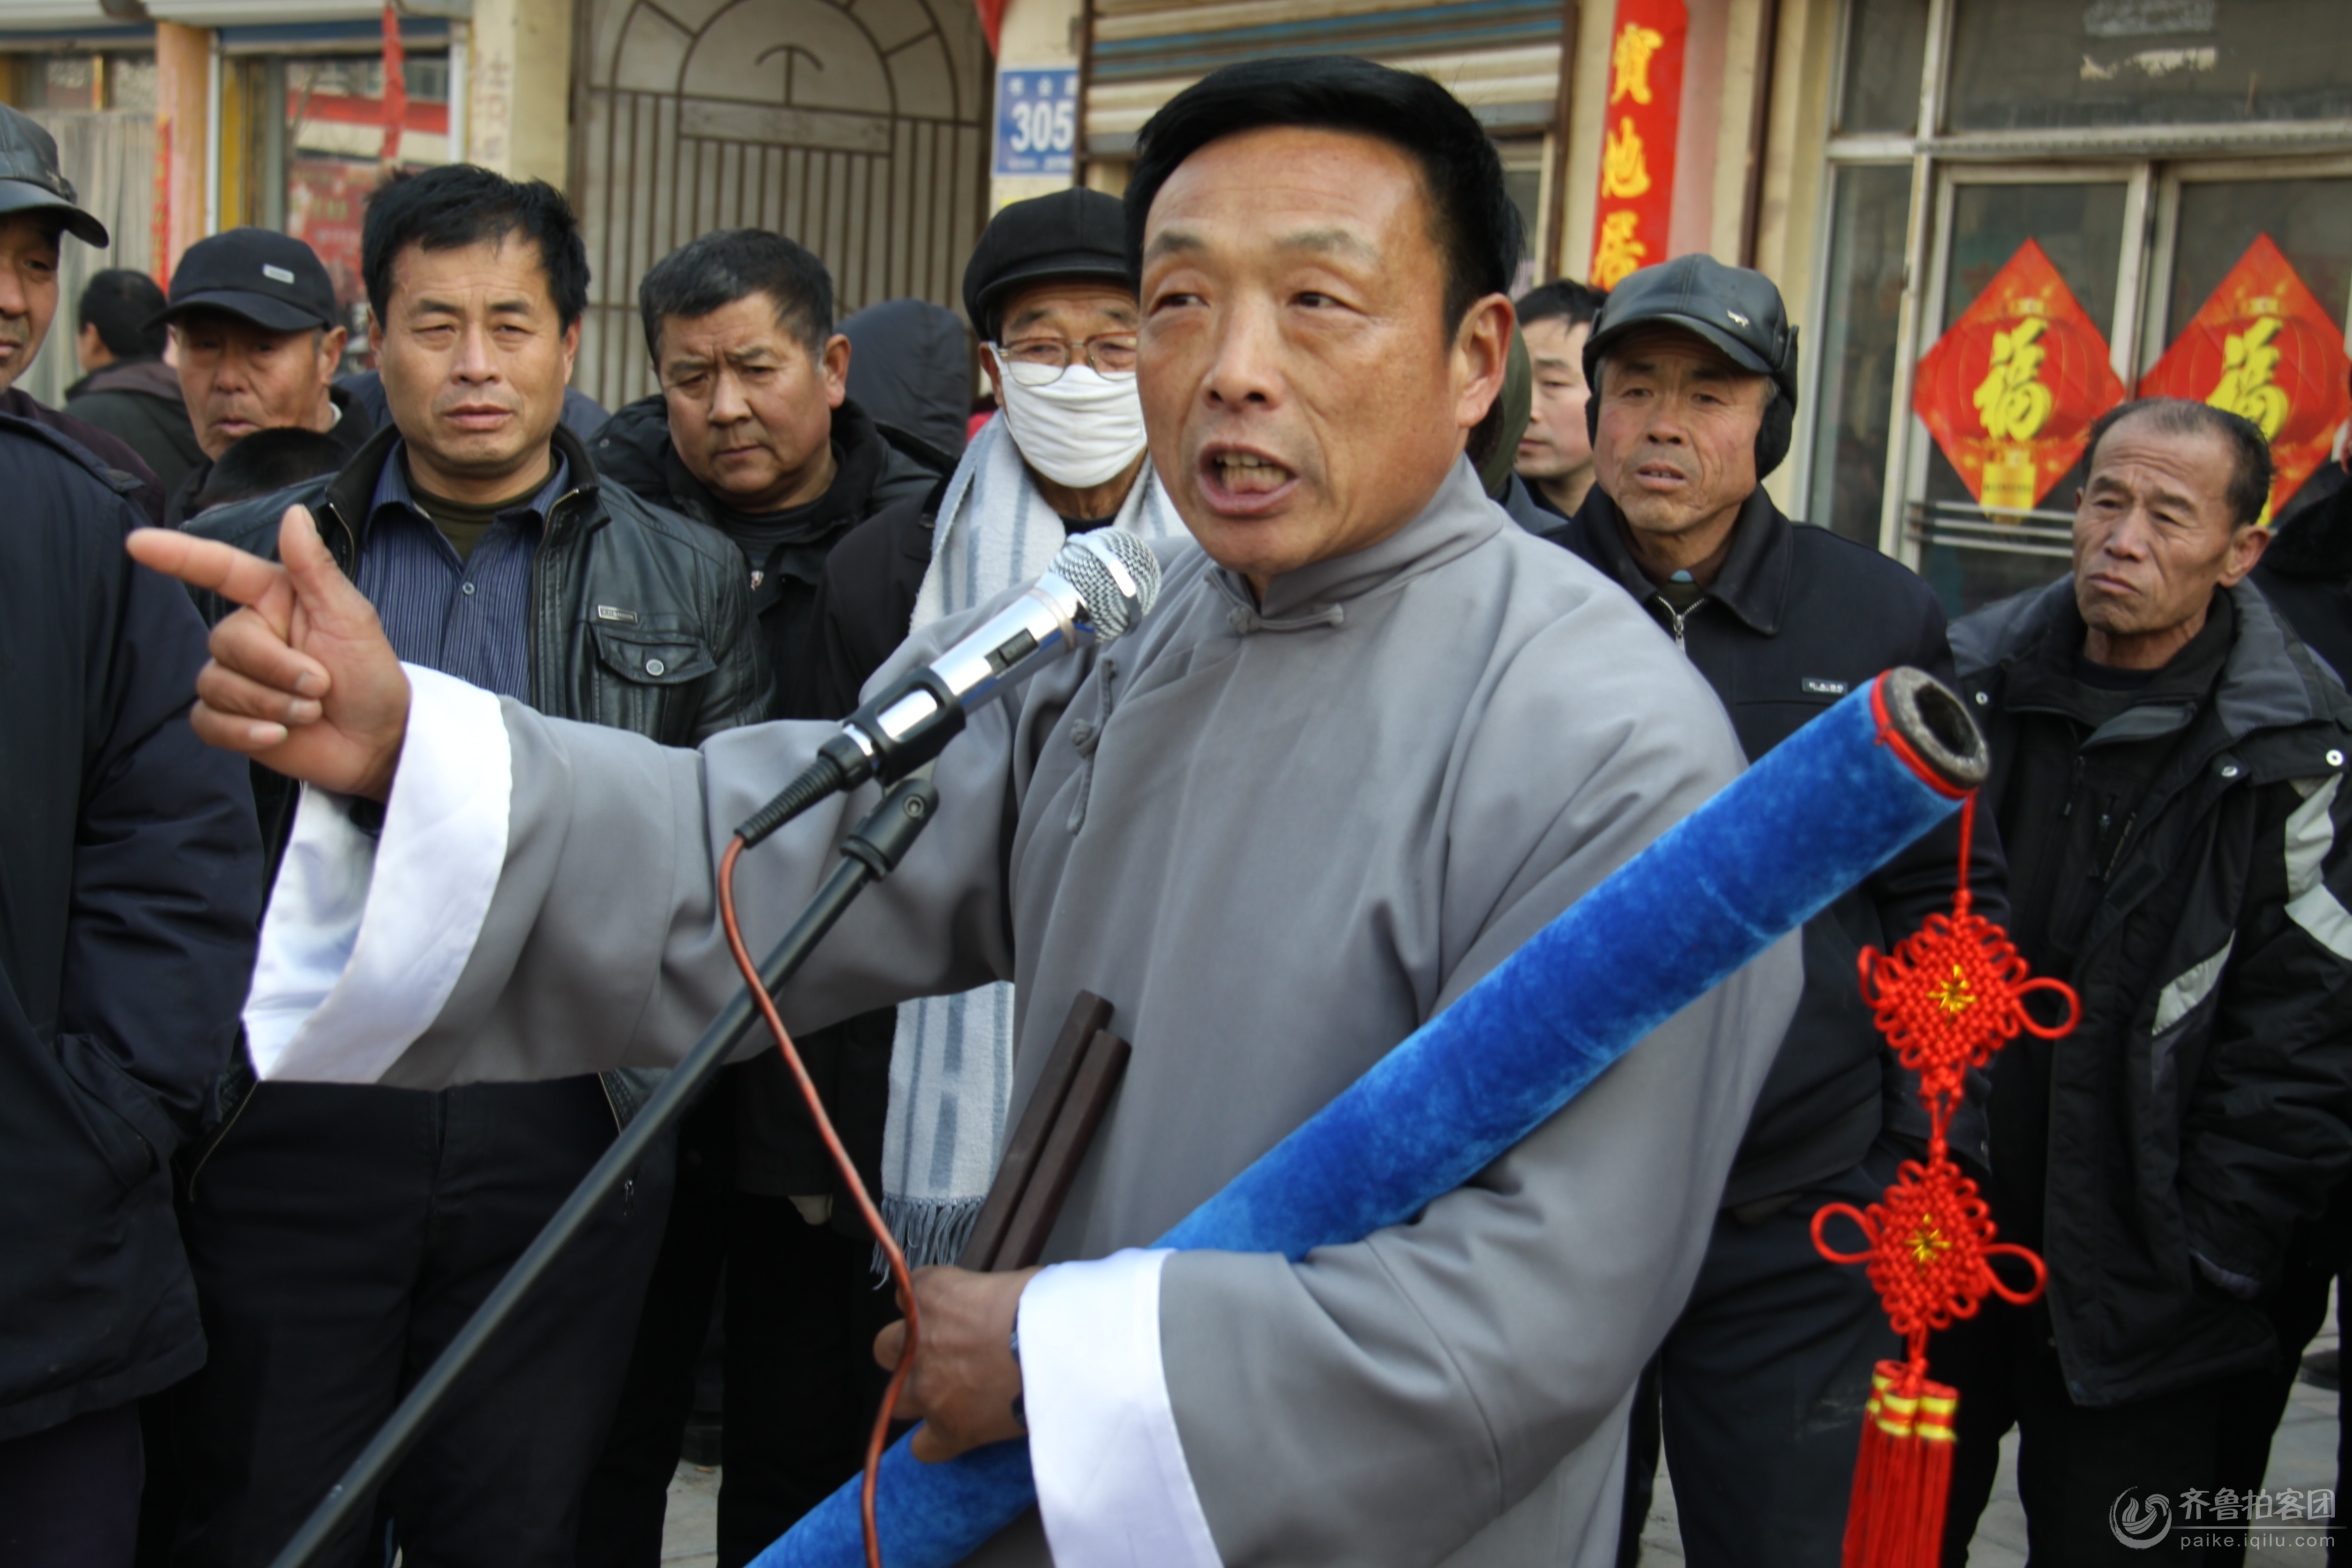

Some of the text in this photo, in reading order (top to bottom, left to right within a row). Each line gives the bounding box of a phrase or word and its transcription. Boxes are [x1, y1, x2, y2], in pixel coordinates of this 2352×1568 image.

[1010, 101, 1075, 152] 305
[1973, 316, 2052, 442] 福
[2206, 316, 2290, 444] 福
